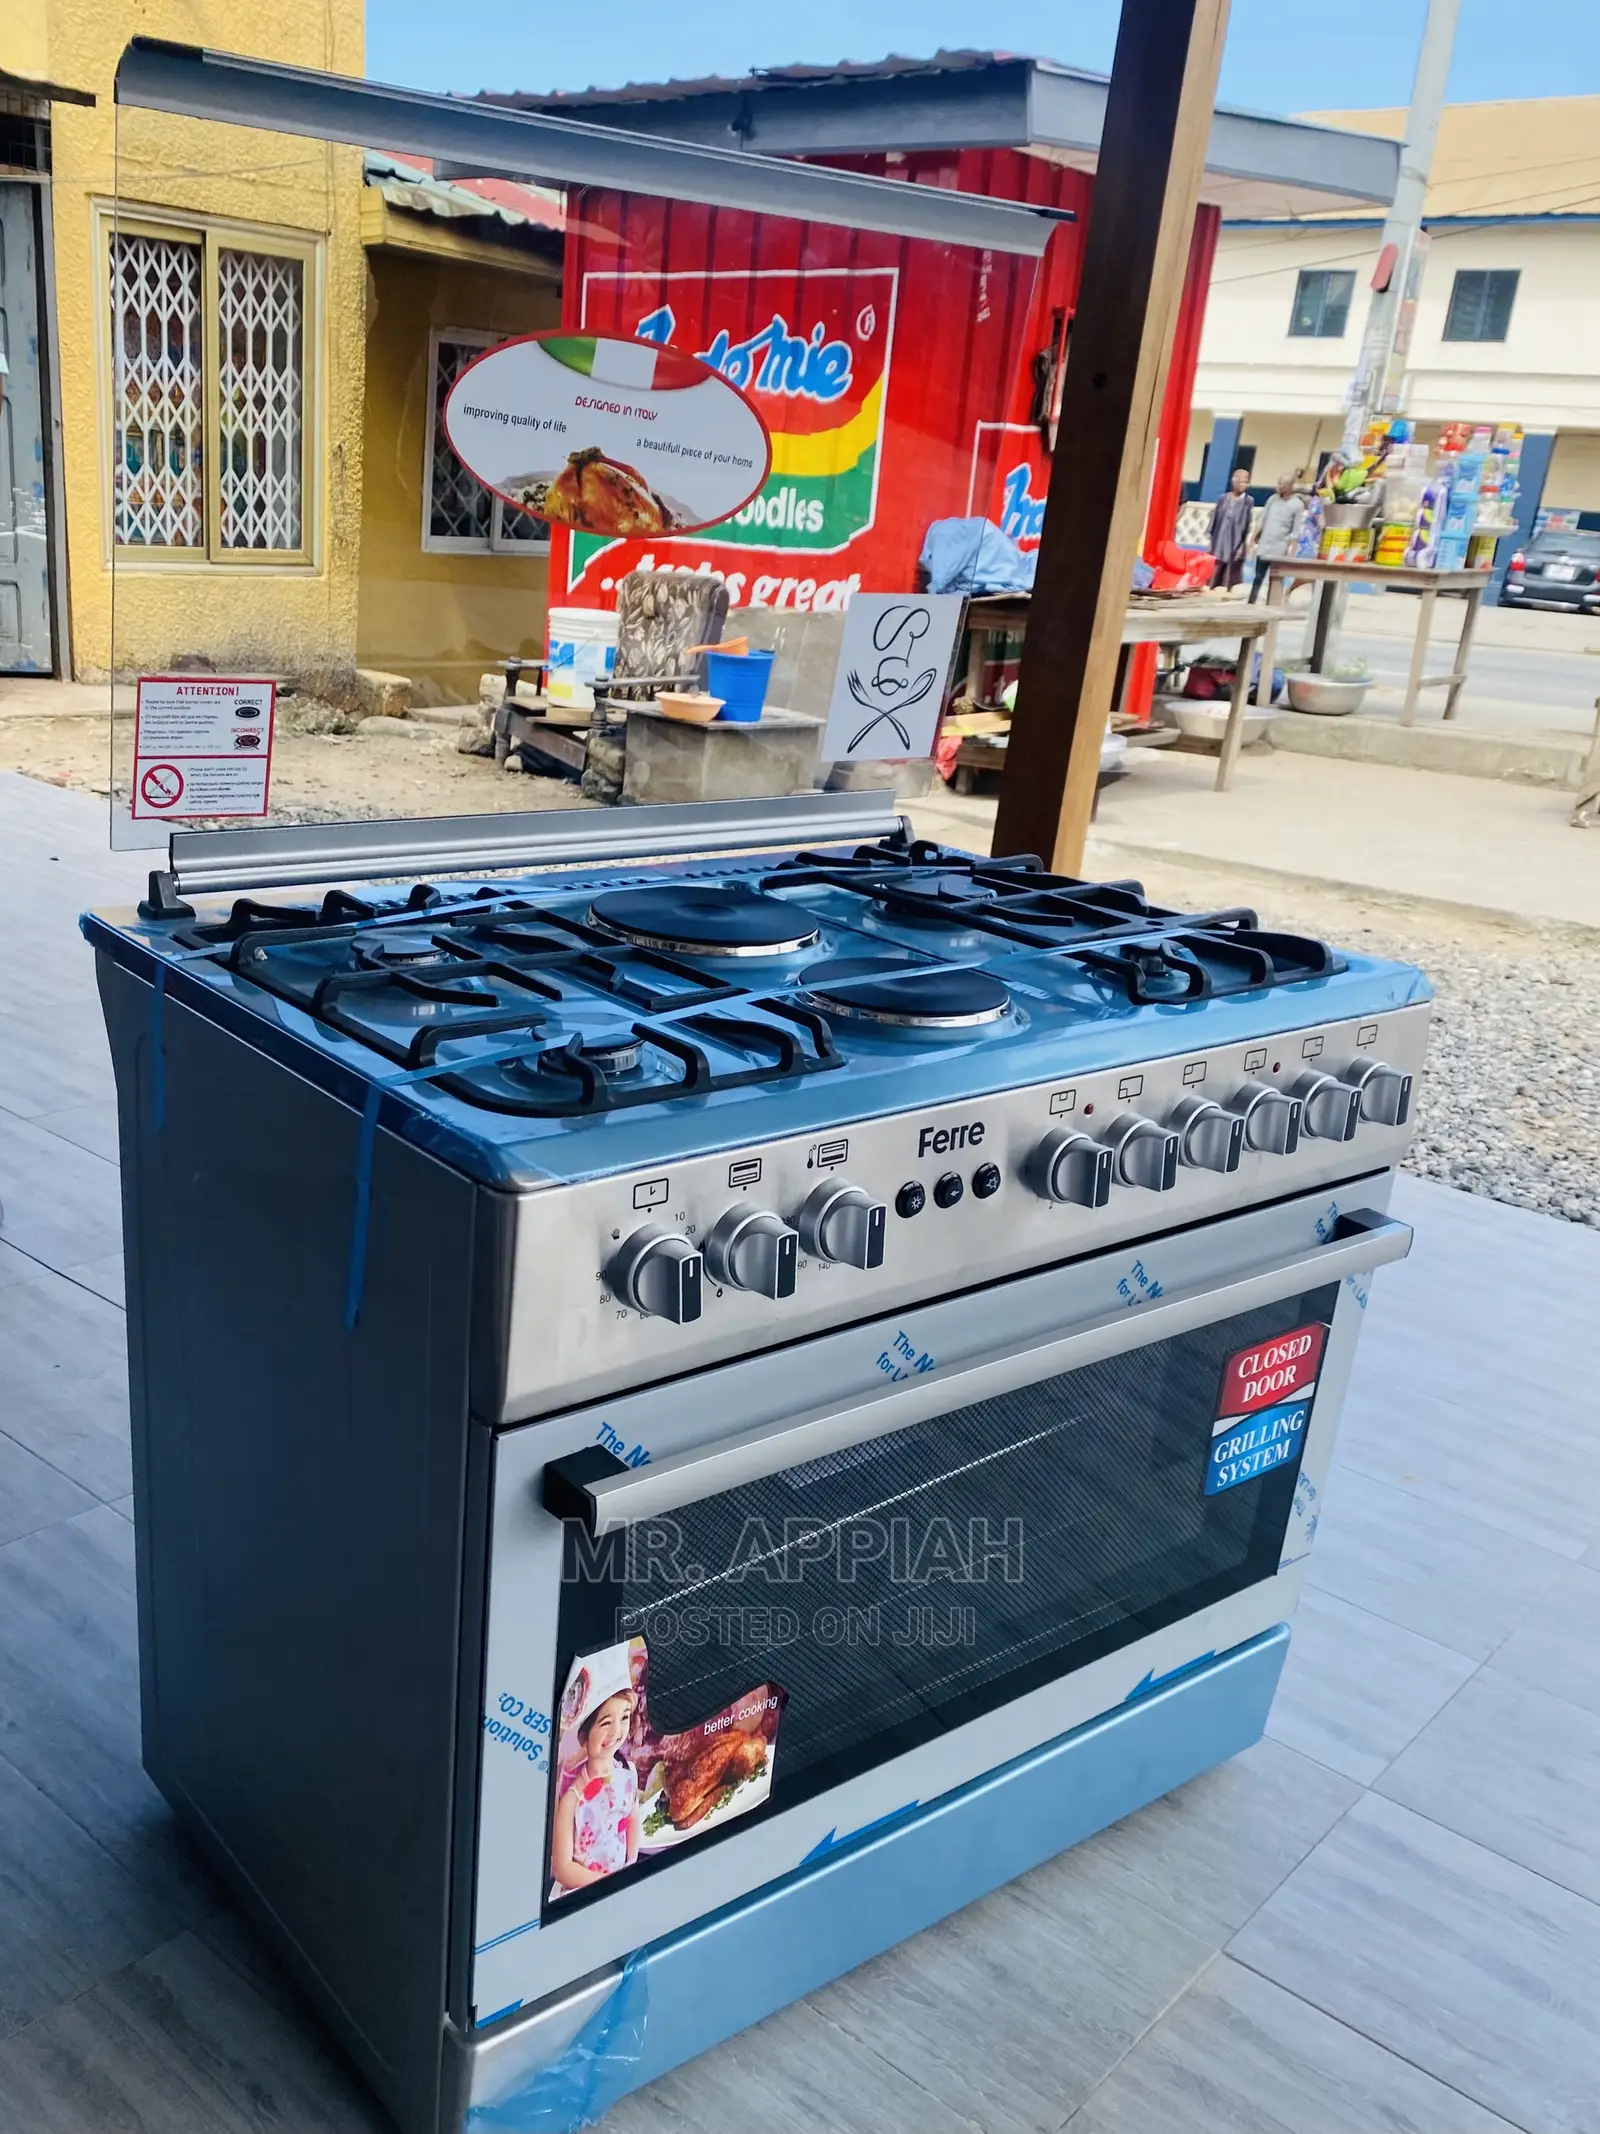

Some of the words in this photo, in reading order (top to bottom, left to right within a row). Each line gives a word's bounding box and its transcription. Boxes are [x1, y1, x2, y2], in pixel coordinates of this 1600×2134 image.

[463, 404, 509, 425] improving
[511, 415, 541, 431] quality
[542, 419, 553, 430] of
[553, 421, 567, 433] life
[575, 396, 621, 413] DESIGNED
[634, 407, 658, 421] ITALY
[636, 438, 642, 447] a
[643, 438, 681, 454] beautifull
[681, 447, 702, 458] piece
[704, 450, 713, 460] of
[713, 454, 731, 464] your
[732, 454, 753, 468] home
[725, 486, 824, 533] oodles
[176, 686, 240, 696] ATTENTION!
[918, 1121, 985, 1158] Ferre
[674, 1211, 686, 1221] 10
[685, 1225, 696, 1235] 20
[595, 1270, 607, 1281] 90
[1117, 1278, 1131, 1298] for
[1131, 1260, 1148, 1287] The
[599, 1293, 611, 1304] 80
[616, 1309, 627, 1320] 70
[893, 1330, 915, 1360] The
[1238, 1334, 1312, 1379] CLOSED
[876, 1351, 895, 1374] for
[1242, 1364, 1297, 1403] DOOR
[596, 1421, 625, 1455] The
[1214, 1410, 1305, 1464] GRILLING
[1217, 1439, 1292, 1488] SYSTEM
[704, 1713, 735, 1736] better
[738, 1696, 778, 1721] cooking
